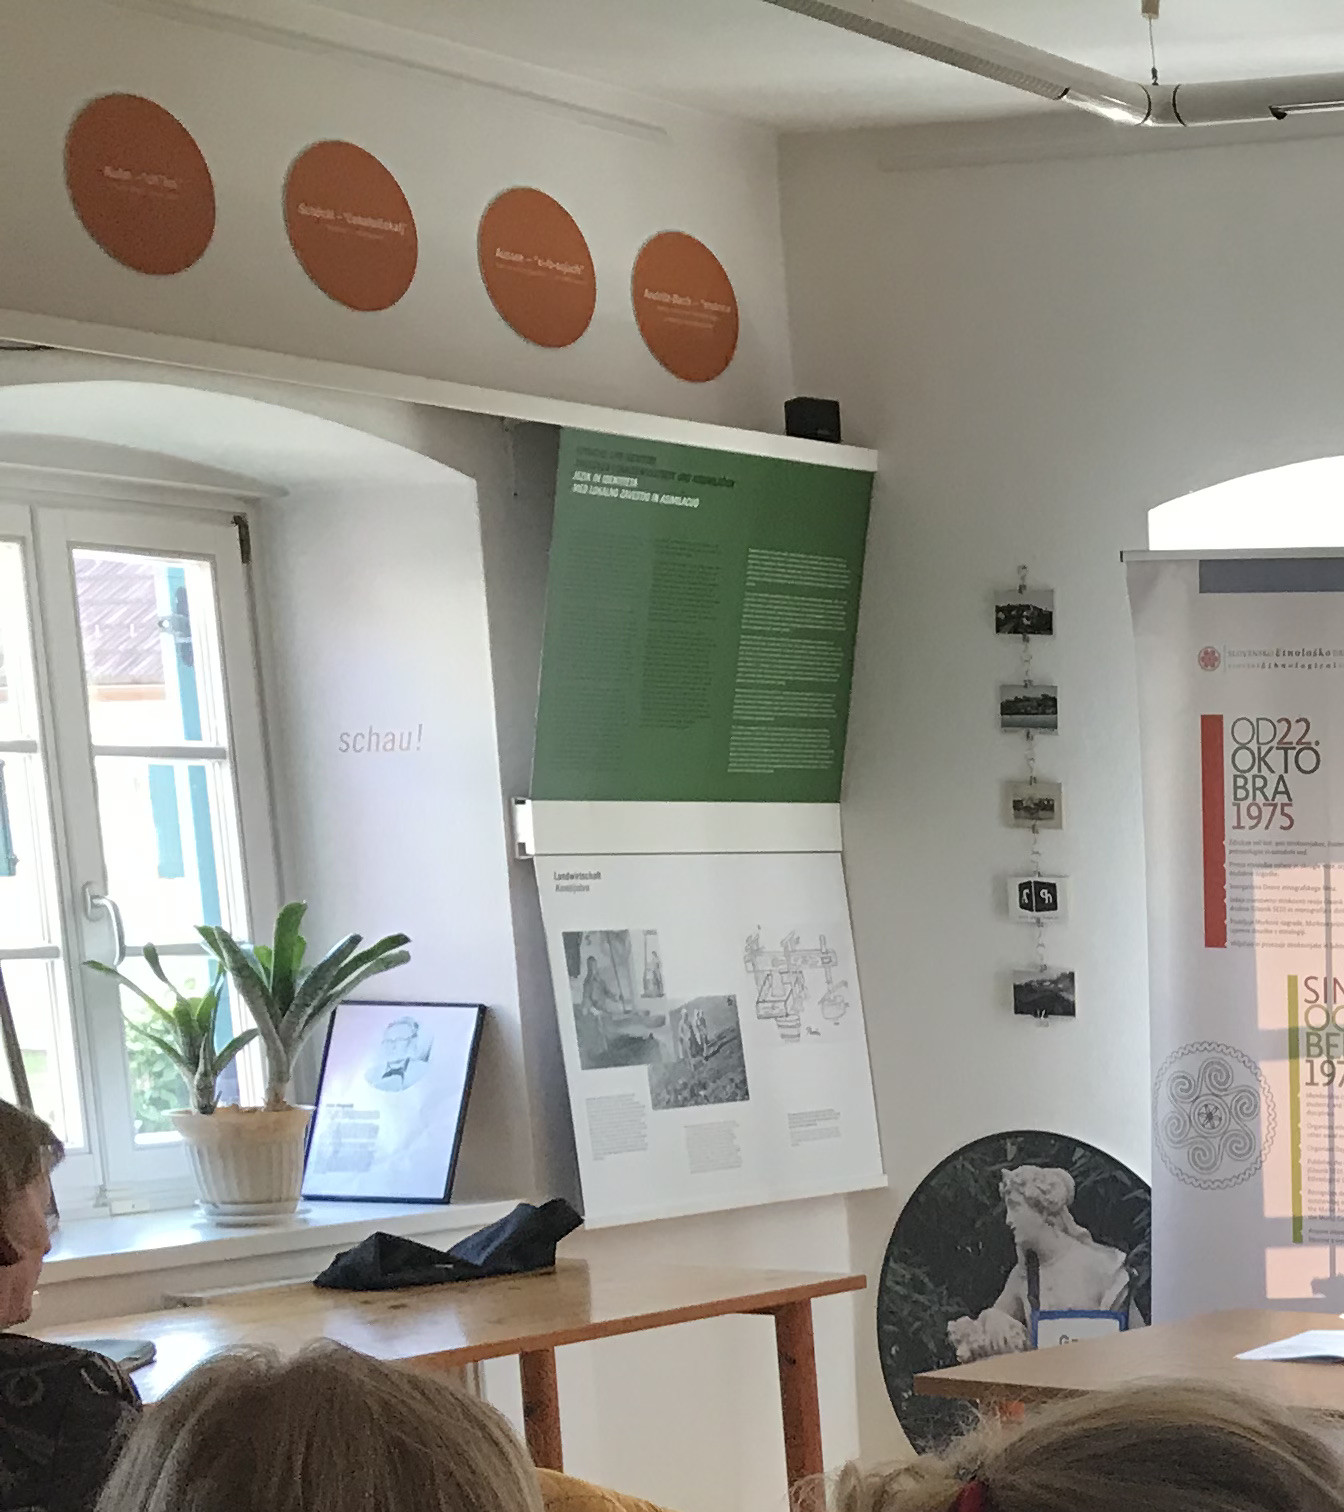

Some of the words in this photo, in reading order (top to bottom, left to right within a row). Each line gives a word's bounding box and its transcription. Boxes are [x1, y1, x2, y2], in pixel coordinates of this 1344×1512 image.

[338, 723, 423, 753] schau!
[1231, 746, 1321, 775] OKTO
[1232, 773, 1293, 803] BRA
[1231, 801, 1295, 831] 1975
